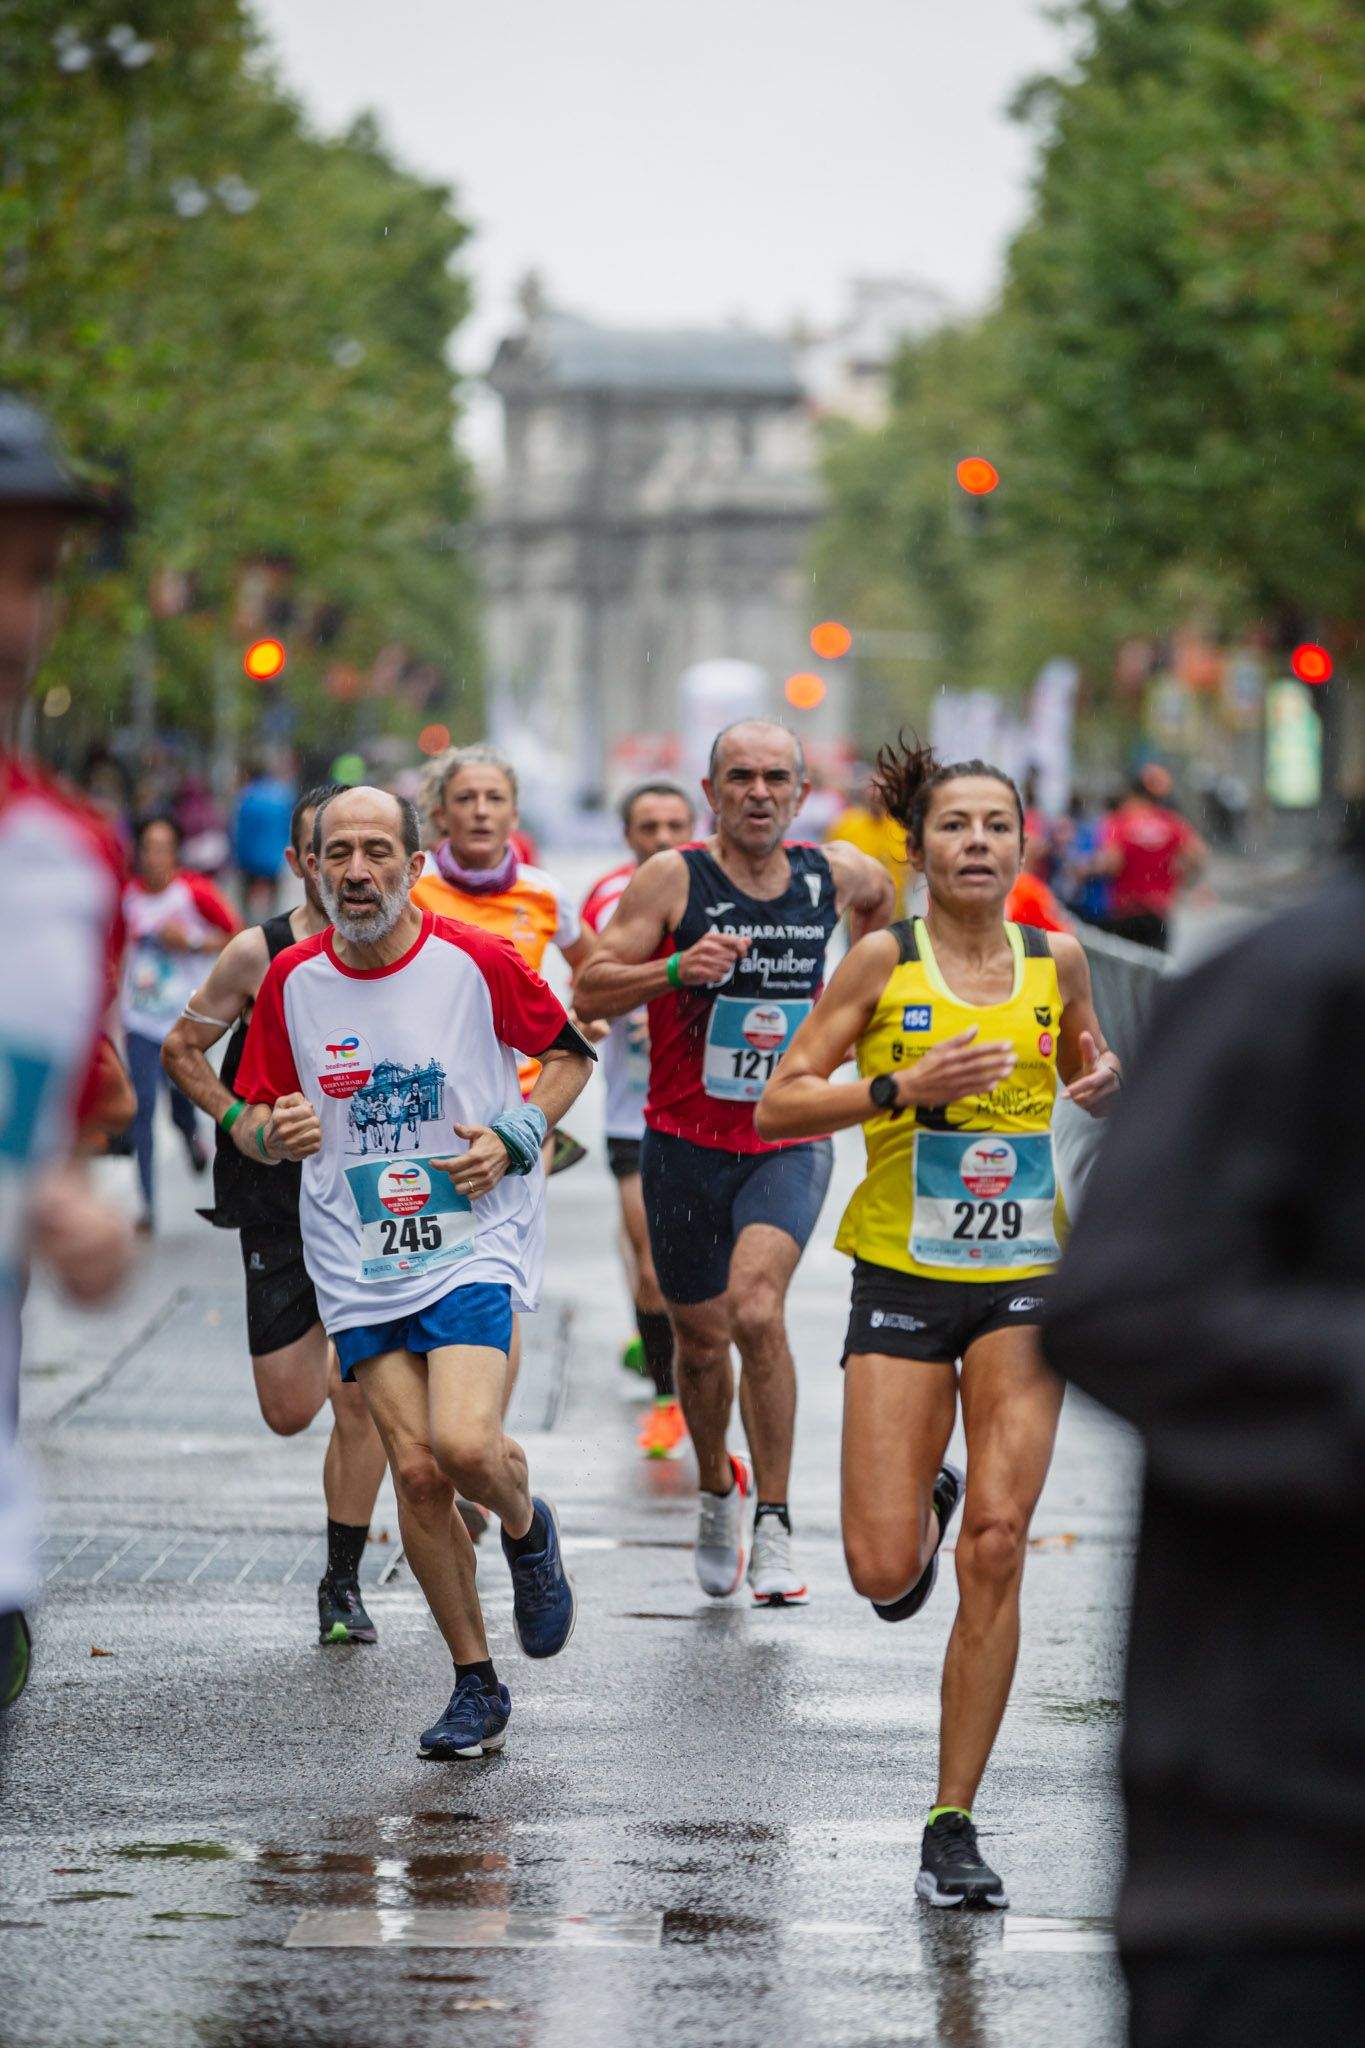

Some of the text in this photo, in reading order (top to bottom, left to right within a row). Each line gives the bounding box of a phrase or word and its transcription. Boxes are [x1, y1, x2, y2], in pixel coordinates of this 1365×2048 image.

[739, 925, 825, 939] MARATHON
[739, 948, 817, 986] alquiber
[731, 1050, 784, 1081] 121
[380, 1215, 442, 1256] 245
[953, 1201, 1022, 1240] 229
